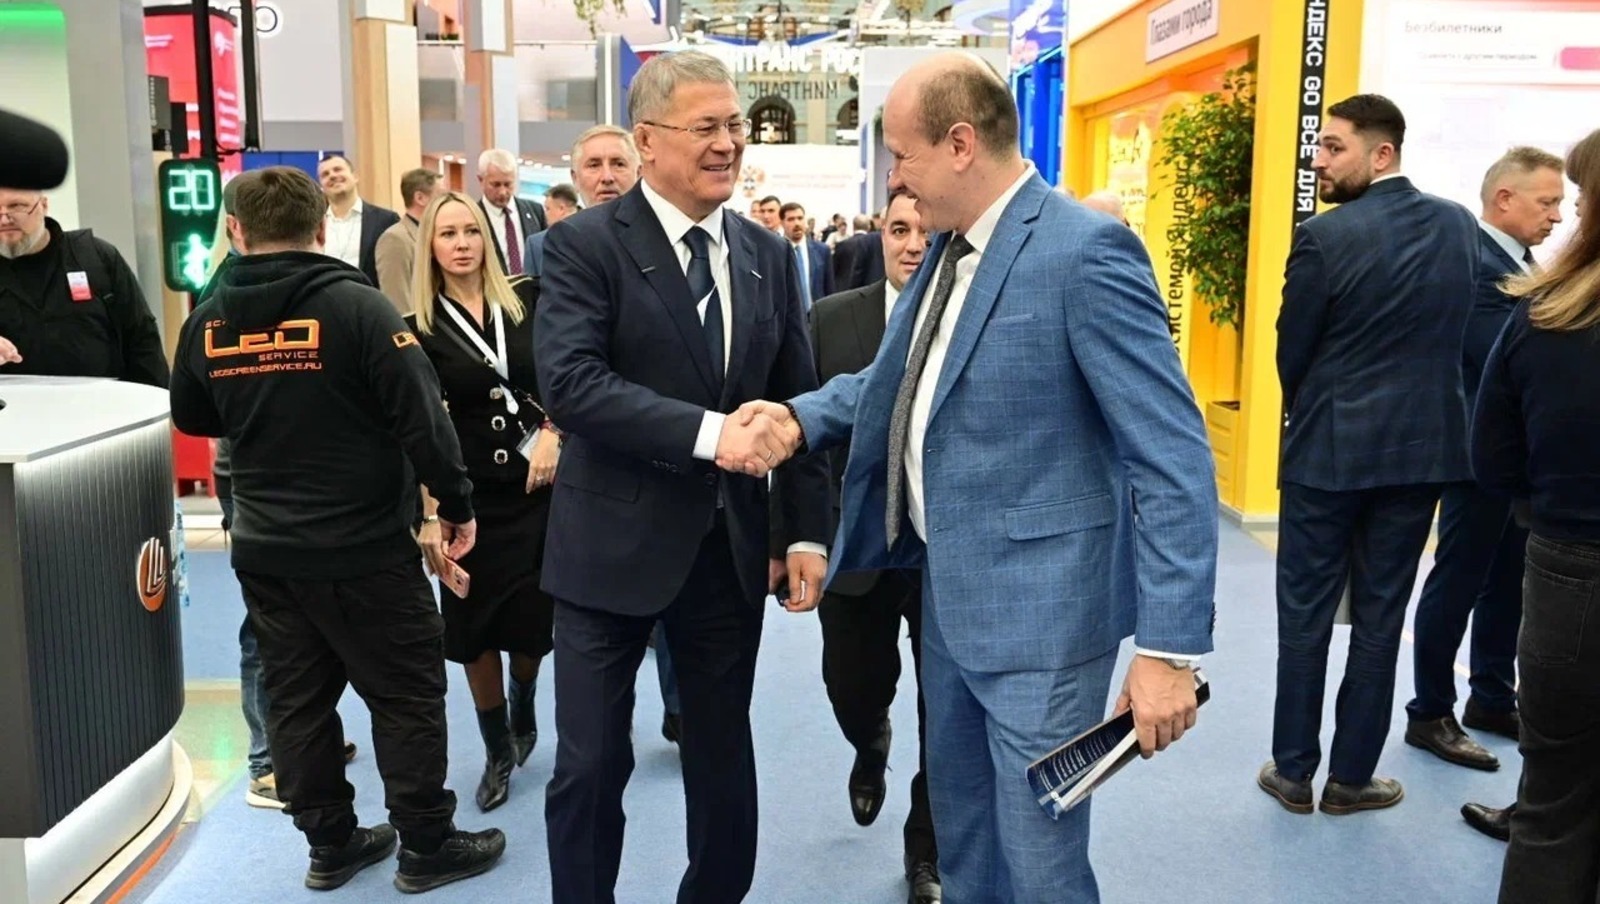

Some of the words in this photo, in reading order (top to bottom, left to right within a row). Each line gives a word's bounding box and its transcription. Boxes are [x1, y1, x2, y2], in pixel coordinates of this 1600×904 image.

[1405, 21, 1503, 34] Безбилетники
[1303, 76, 1321, 105] GO
[168, 169, 215, 211] 20
[1296, 169, 1316, 211] ДЛЯ
[258, 351, 319, 361] SERVICE
[208, 362, 322, 378] LEDSCREENSERVICE.RU
